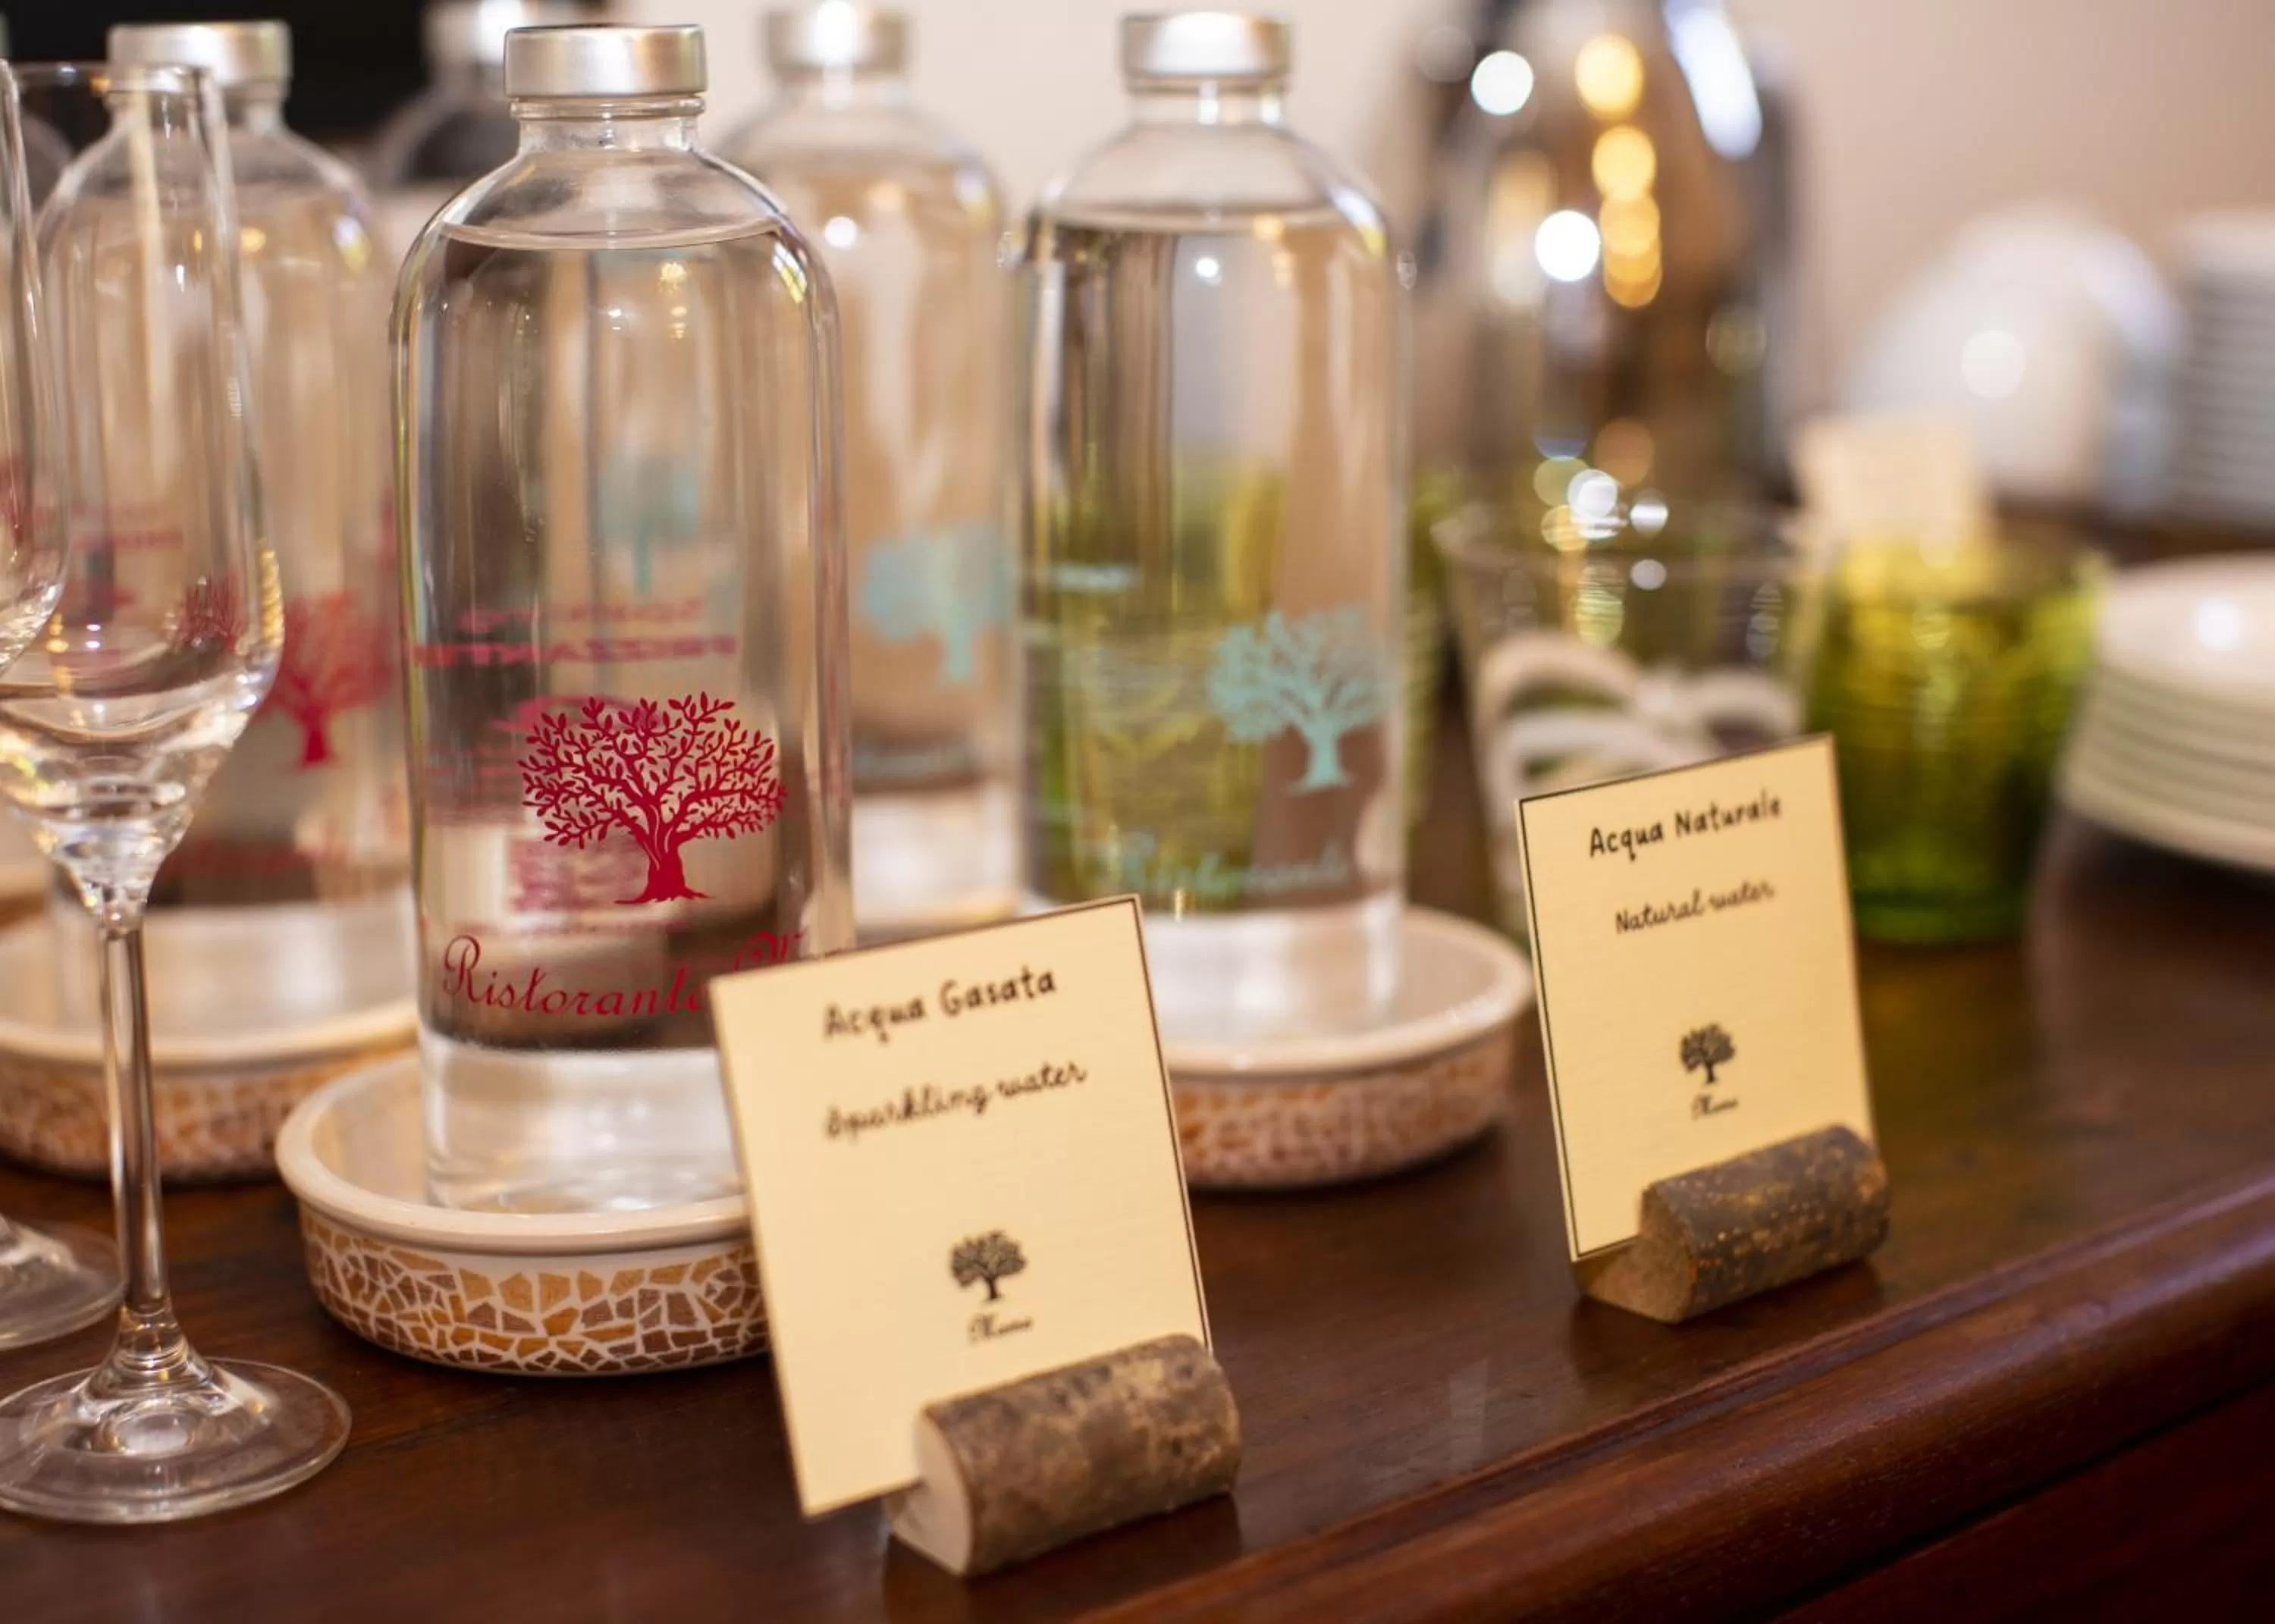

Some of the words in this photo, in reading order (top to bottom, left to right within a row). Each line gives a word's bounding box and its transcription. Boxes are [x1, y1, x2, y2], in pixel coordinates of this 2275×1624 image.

[1589, 820, 1665, 863] Acqua
[1674, 785, 1782, 839] Naturale
[1614, 887, 1706, 935] Natural
[1708, 879, 1775, 911] water
[441, 933, 704, 1017] Ristorante
[823, 995, 927, 1045] Acqua
[937, 964, 1058, 1019] Gasata
[994, 1058, 1088, 1099] water
